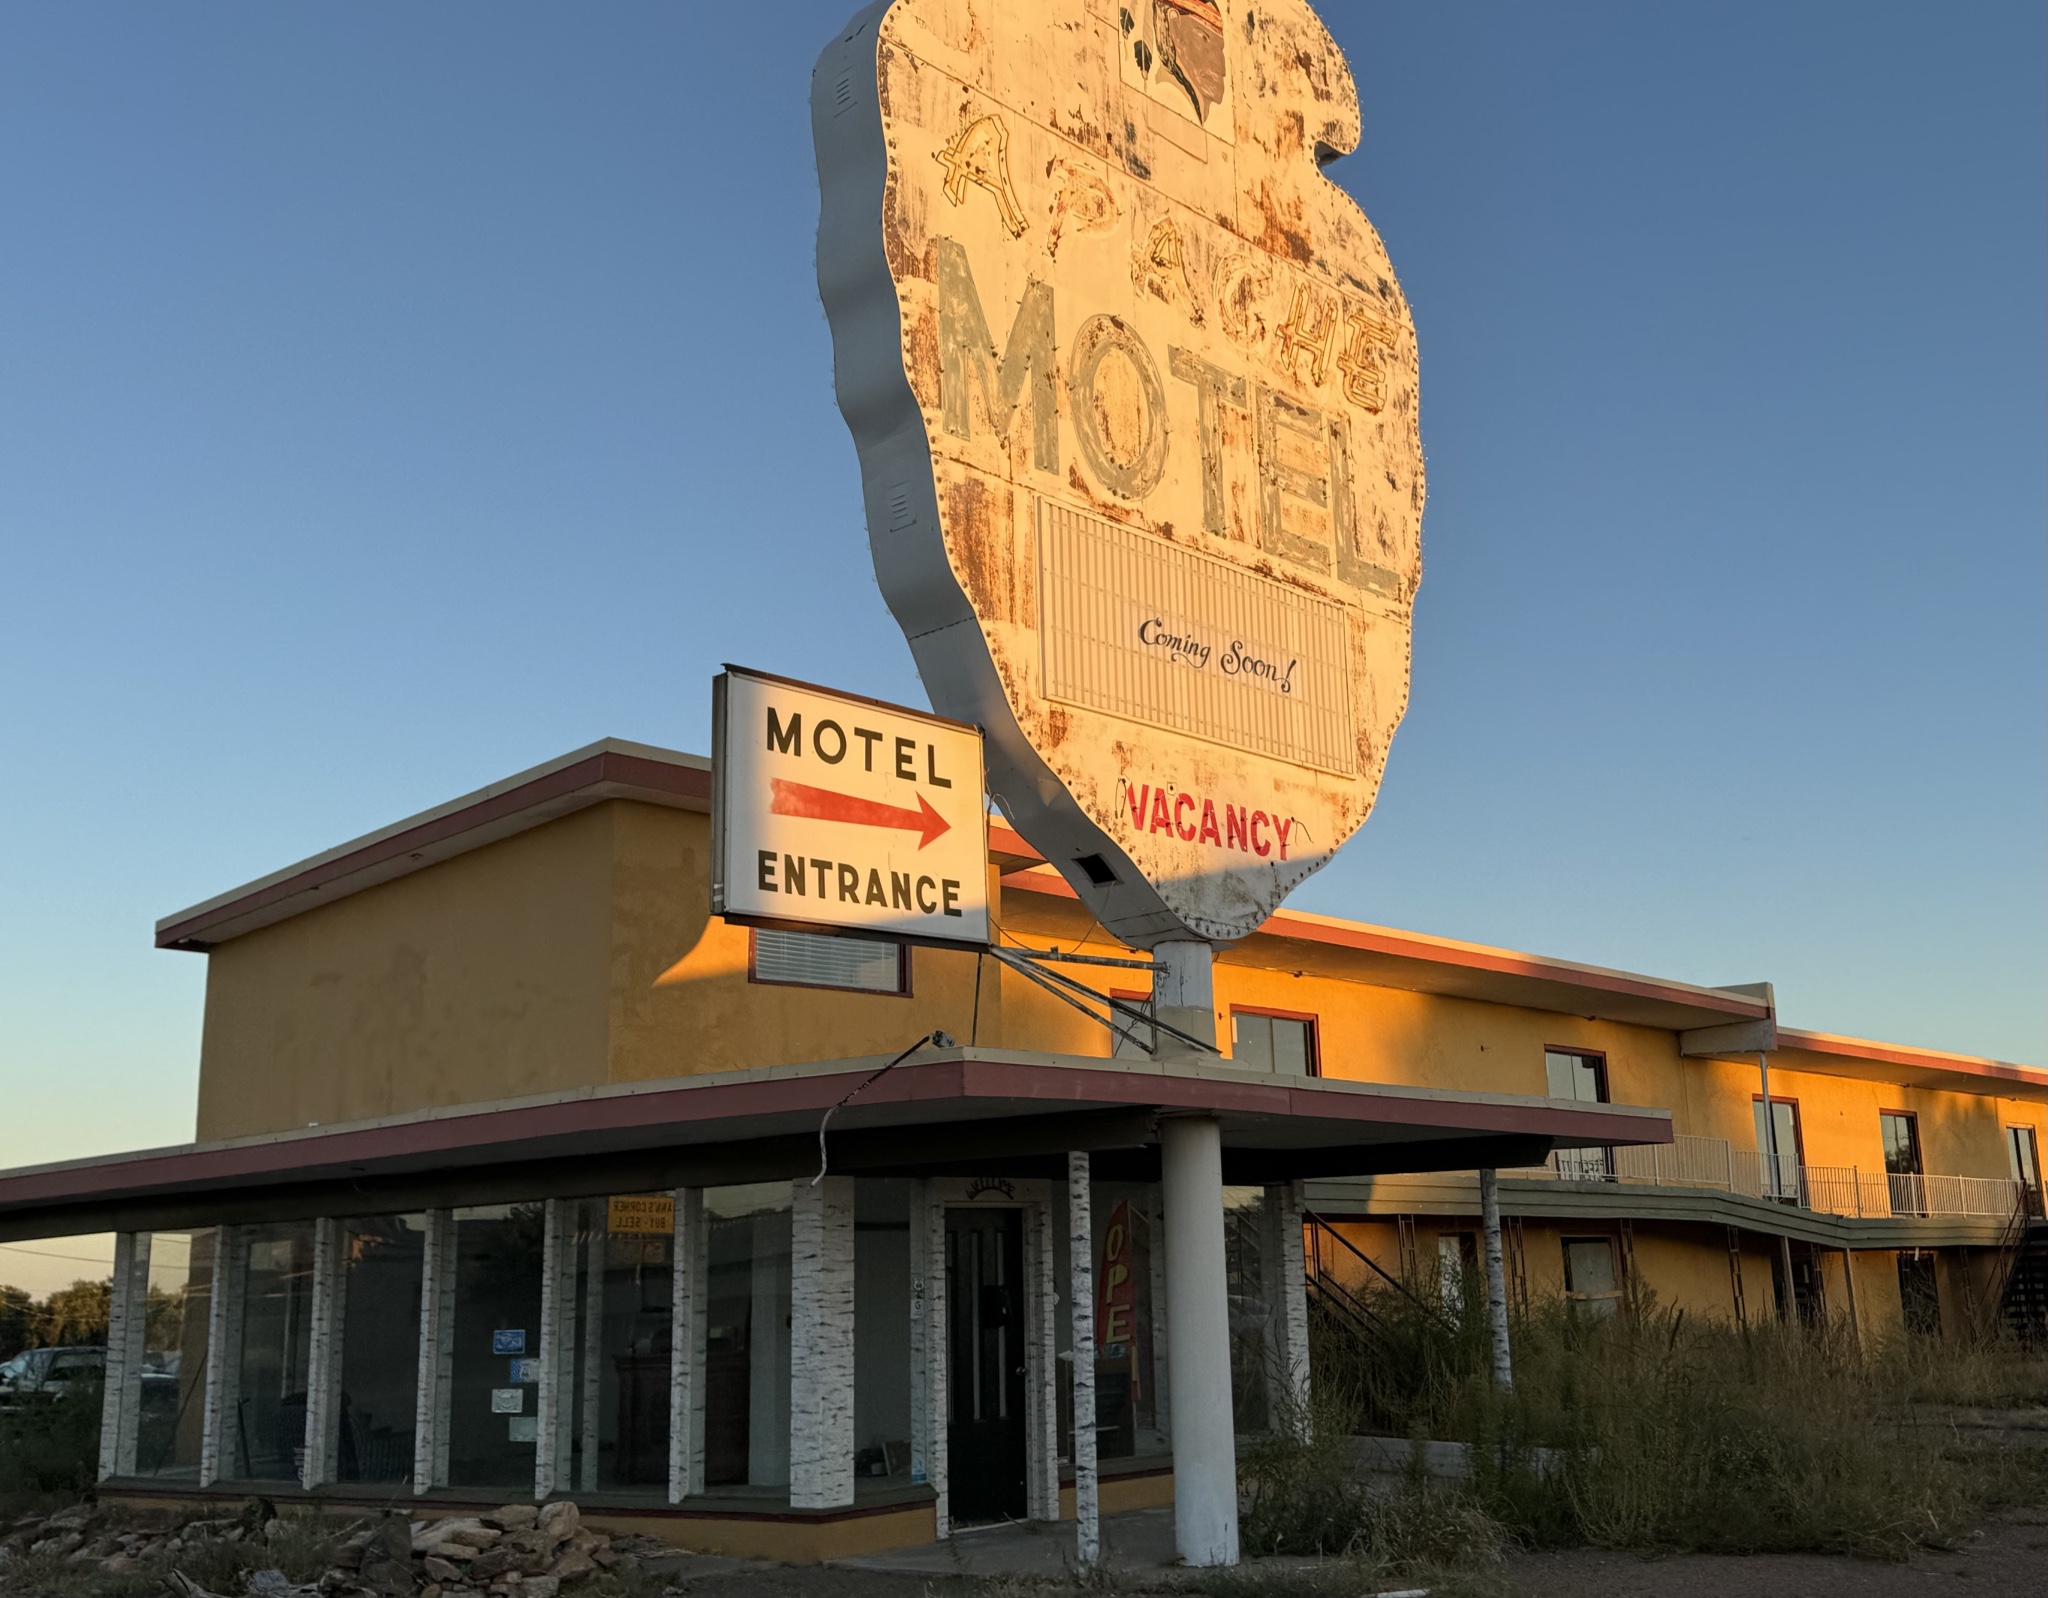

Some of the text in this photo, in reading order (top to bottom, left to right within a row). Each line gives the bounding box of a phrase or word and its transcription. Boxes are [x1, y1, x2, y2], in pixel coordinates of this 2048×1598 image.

[935, 113, 1399, 414] APACHE
[937, 237, 1401, 600] MOTEL
[1139, 617, 1297, 693] Coming Soon!
[767, 706, 952, 789] MOTEL
[1127, 784, 1292, 862] VACANCY
[758, 849, 963, 917] ENTRANCE
